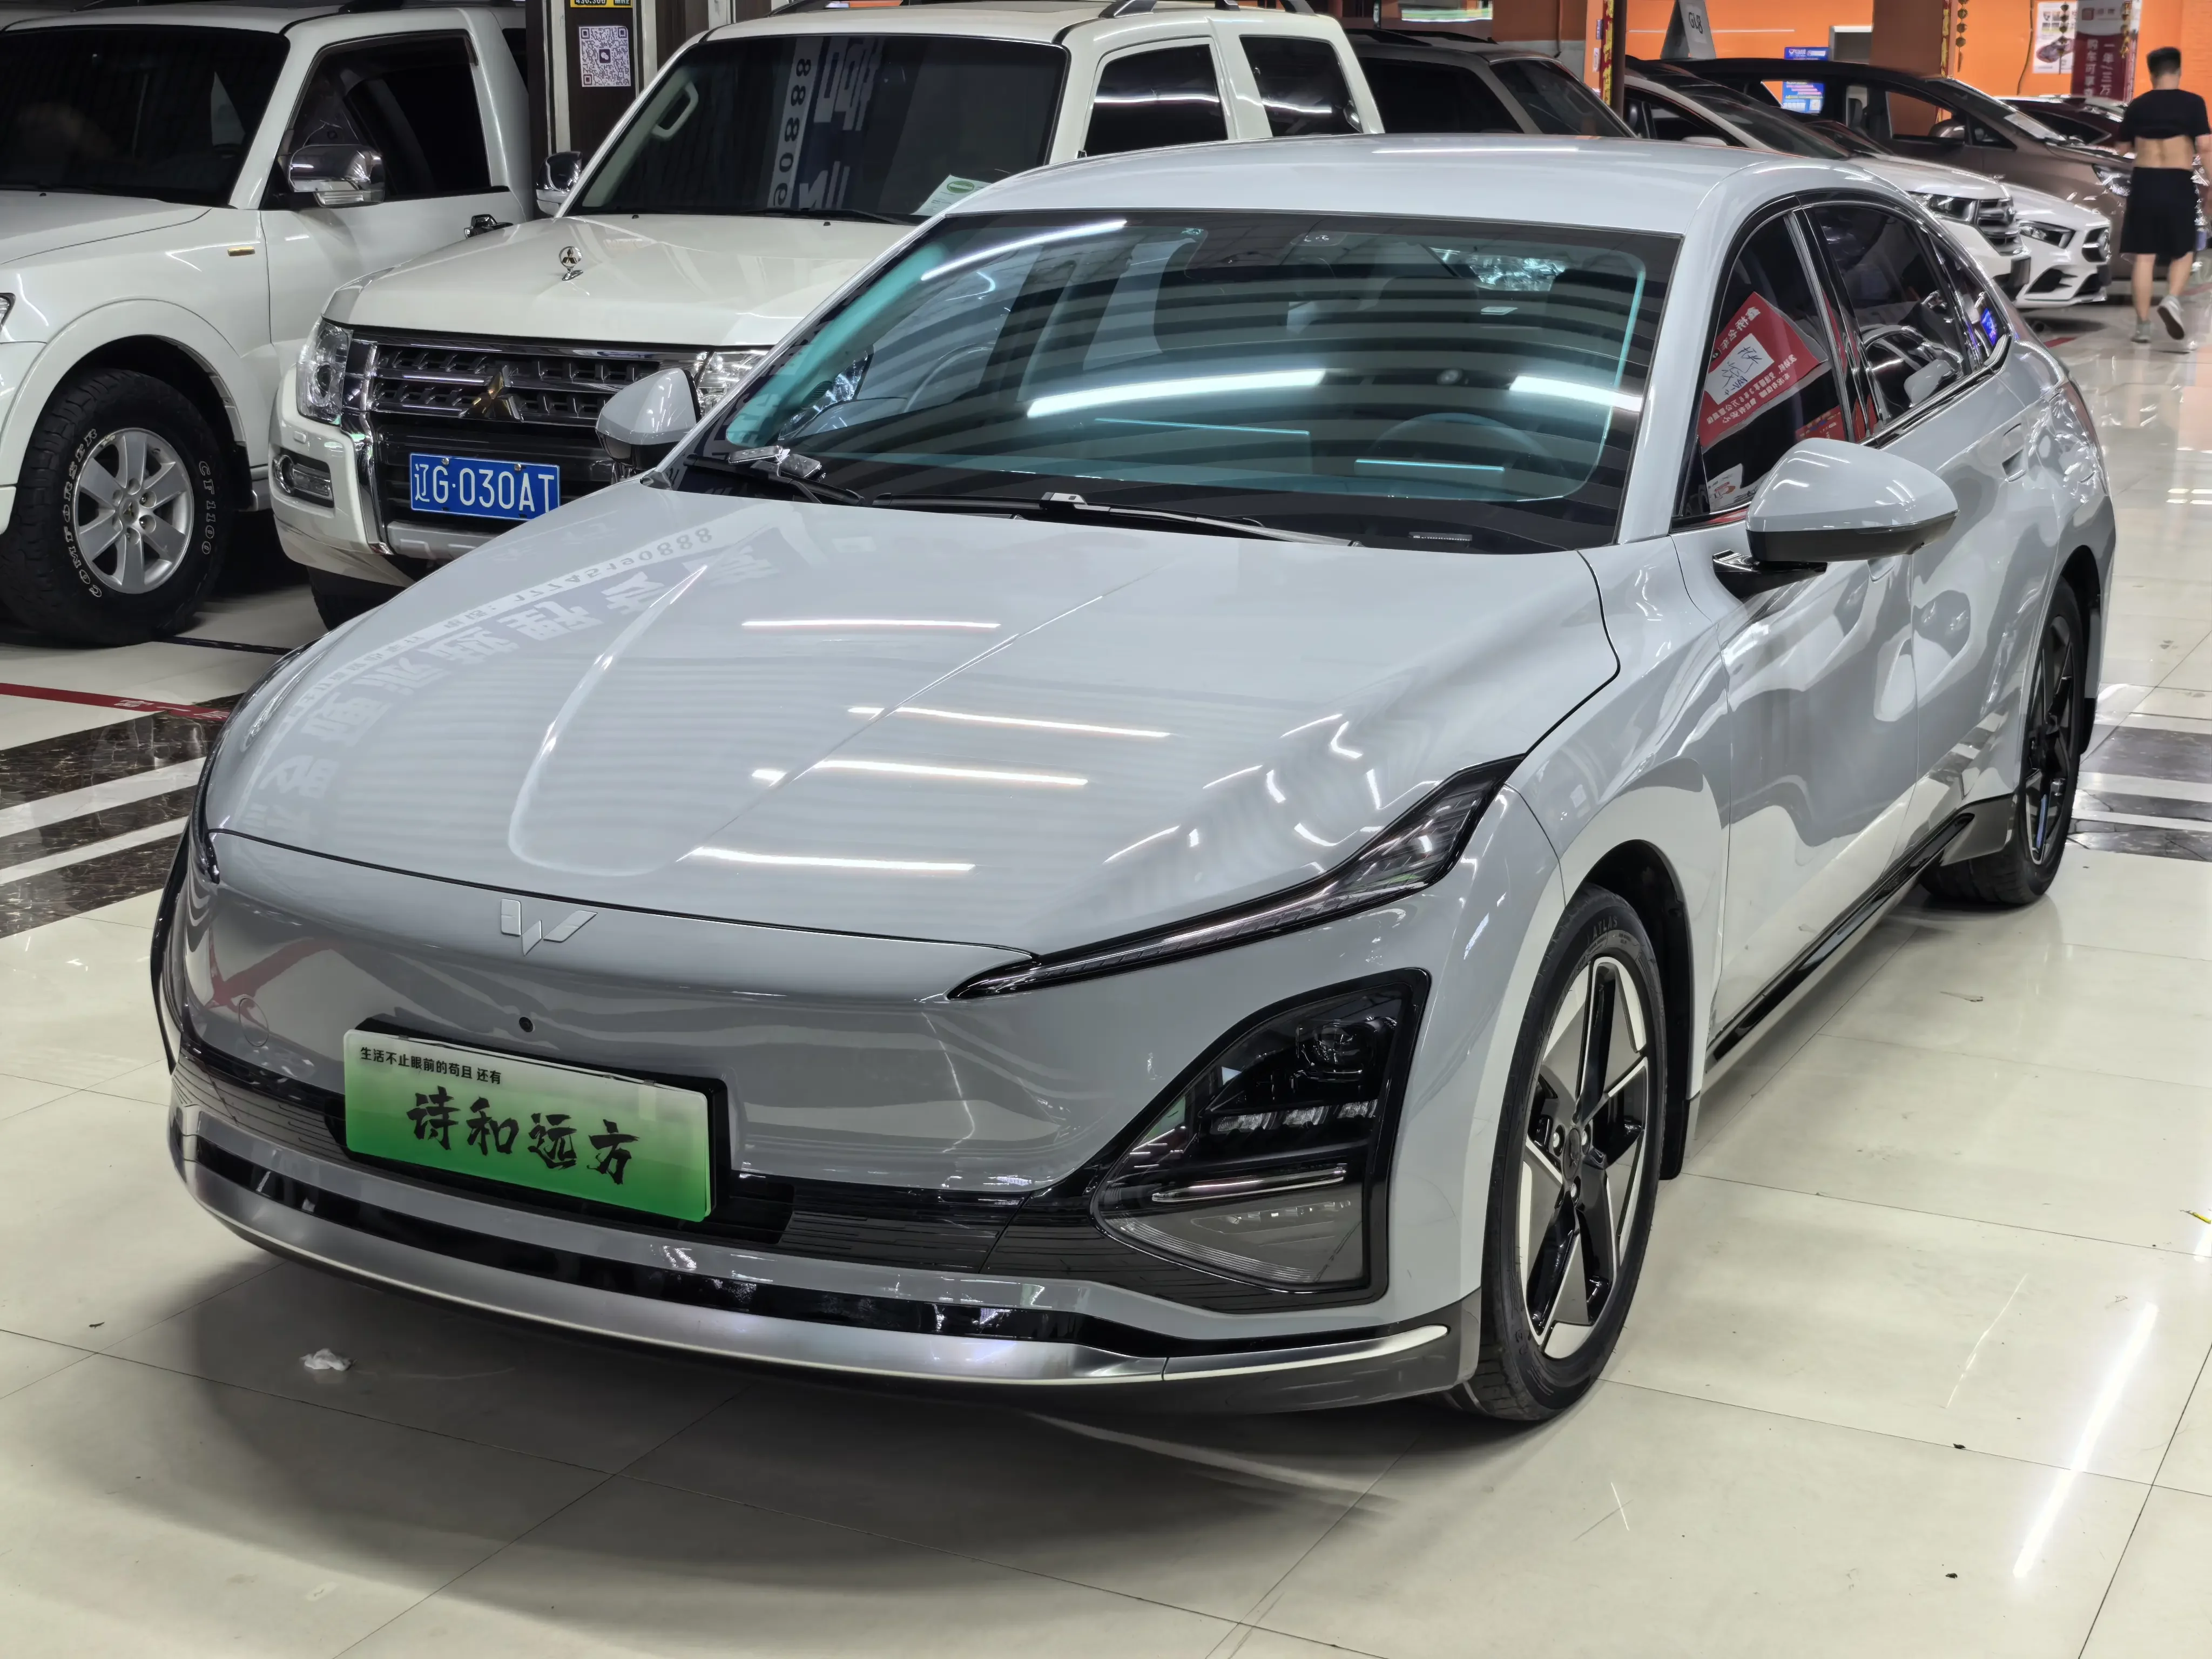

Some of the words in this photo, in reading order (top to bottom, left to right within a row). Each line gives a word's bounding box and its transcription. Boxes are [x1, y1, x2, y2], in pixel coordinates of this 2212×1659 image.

[1688, 11, 1703, 34] GL8
[1593, 915, 1618, 939] ATLAS
[360, 1046, 474, 1080] 生活不止眼前的苟且
[476, 1068, 502, 1085] 还有
[406, 1085, 640, 1185] 诗和远方
